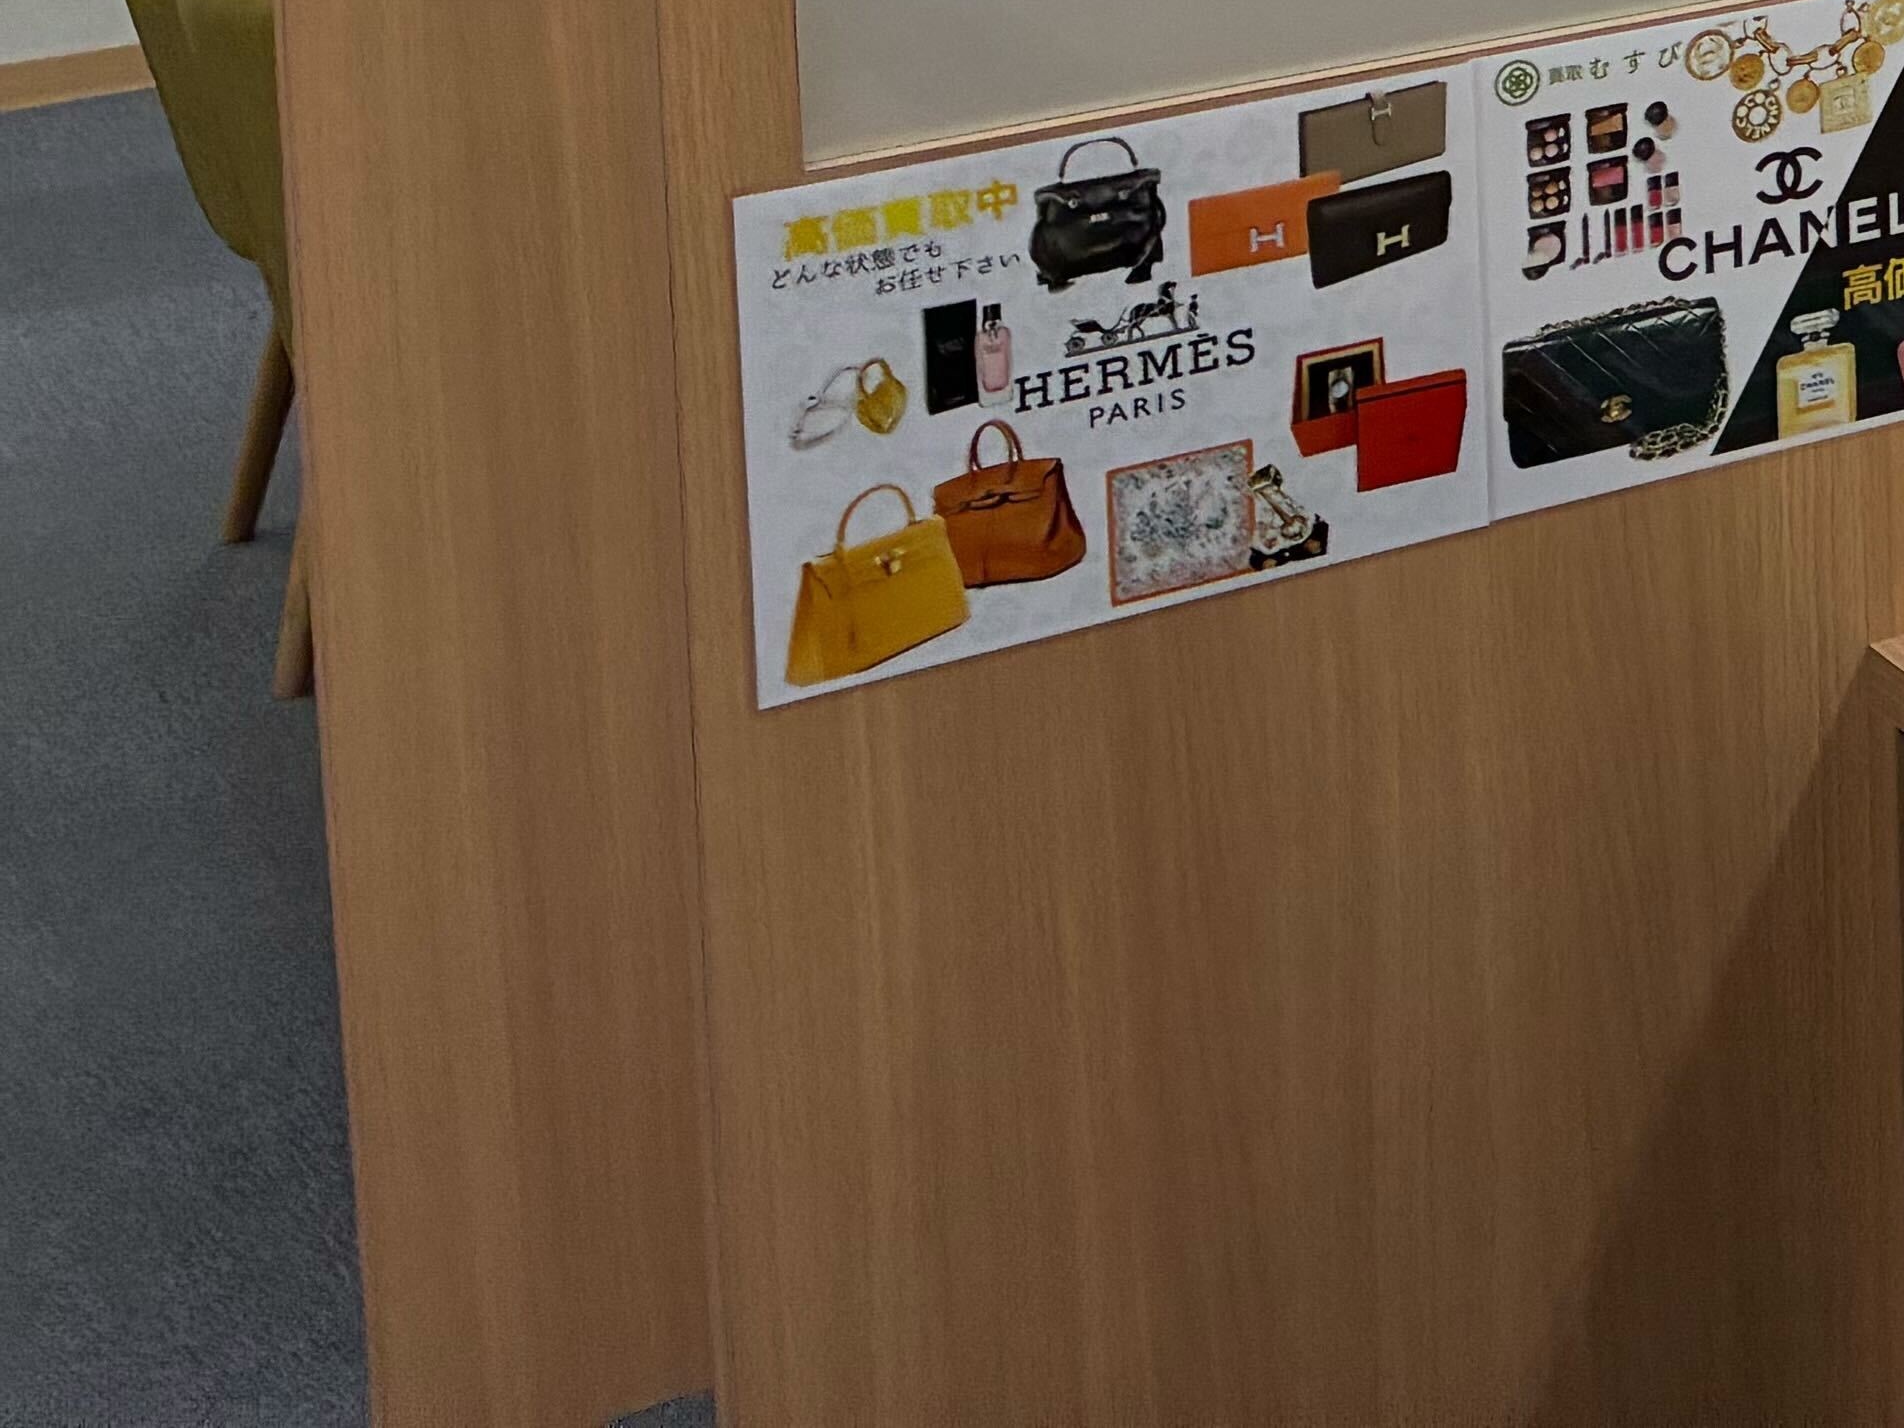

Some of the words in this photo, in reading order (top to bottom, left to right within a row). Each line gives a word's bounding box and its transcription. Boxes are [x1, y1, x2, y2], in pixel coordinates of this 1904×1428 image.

[771, 240, 943, 290] どんな状態でも
[874, 253, 1021, 296] お任せ下さい
[1088, 387, 1187, 429] PARIS
